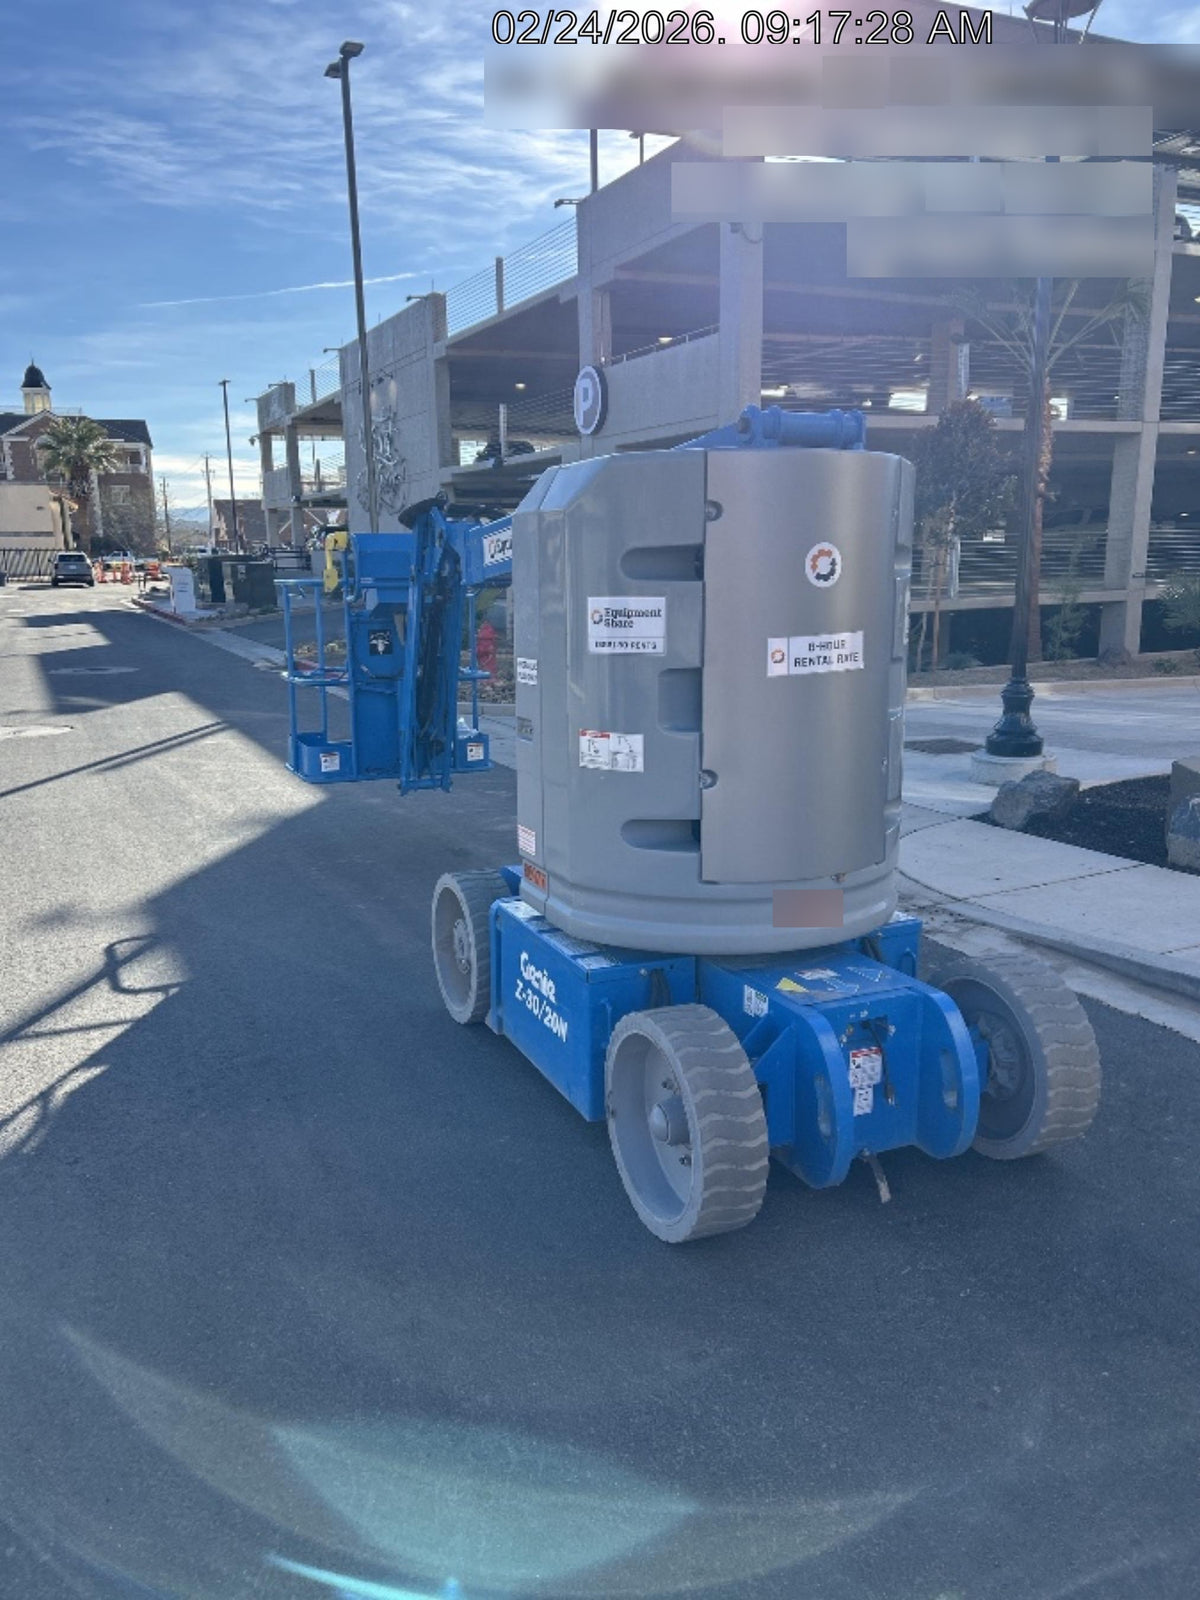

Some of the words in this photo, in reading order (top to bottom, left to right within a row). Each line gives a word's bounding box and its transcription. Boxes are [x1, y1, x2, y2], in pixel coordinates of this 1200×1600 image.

[579, 378, 594, 426] P
[604, 607, 662, 619] Equipment
[604, 618, 634, 629] Share
[794, 655, 834, 668] RENTAL
[520, 951, 556, 1004] Genie
[515, 979, 568, 1043] Z-30/20N
